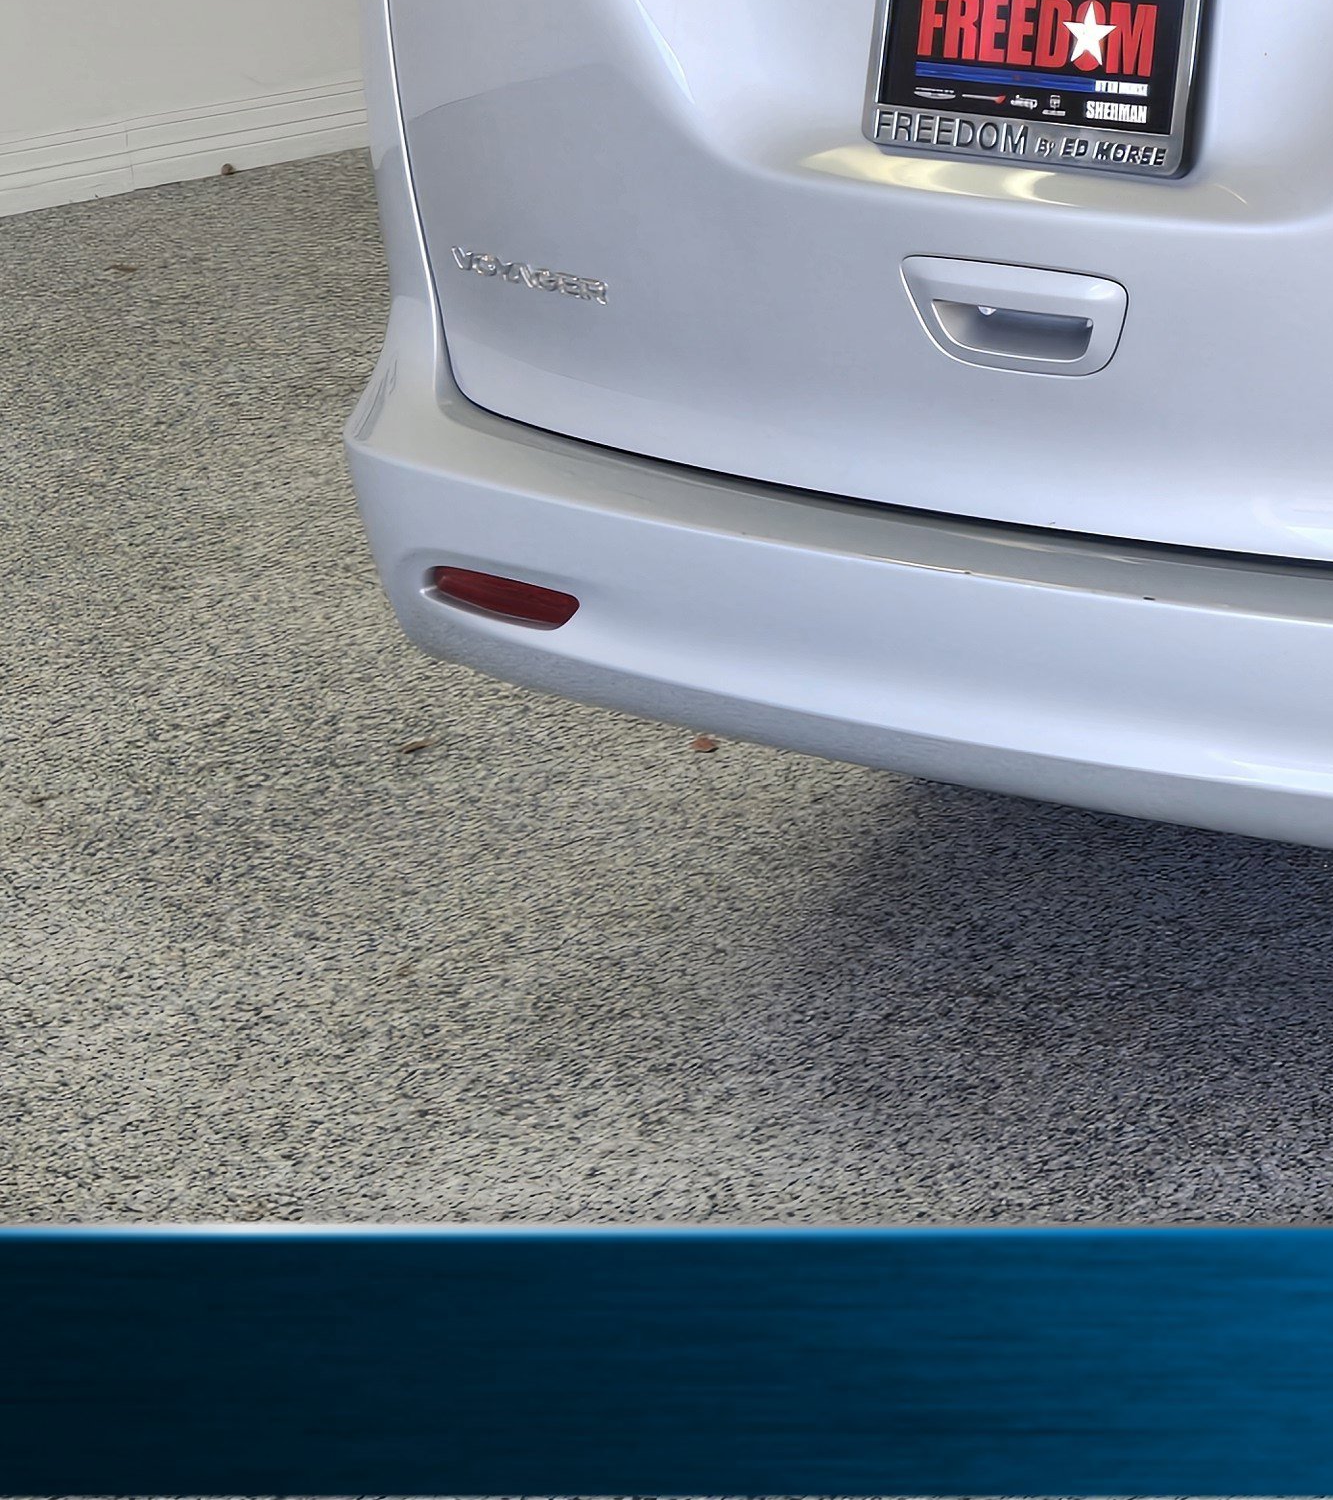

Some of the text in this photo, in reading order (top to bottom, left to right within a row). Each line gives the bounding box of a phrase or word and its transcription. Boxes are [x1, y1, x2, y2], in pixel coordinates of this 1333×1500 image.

[1085, 100, 1149, 125] SHERMAN
[873, 108, 1029, 155] FREEDOM
[1059, 137, 1090, 159] ED
